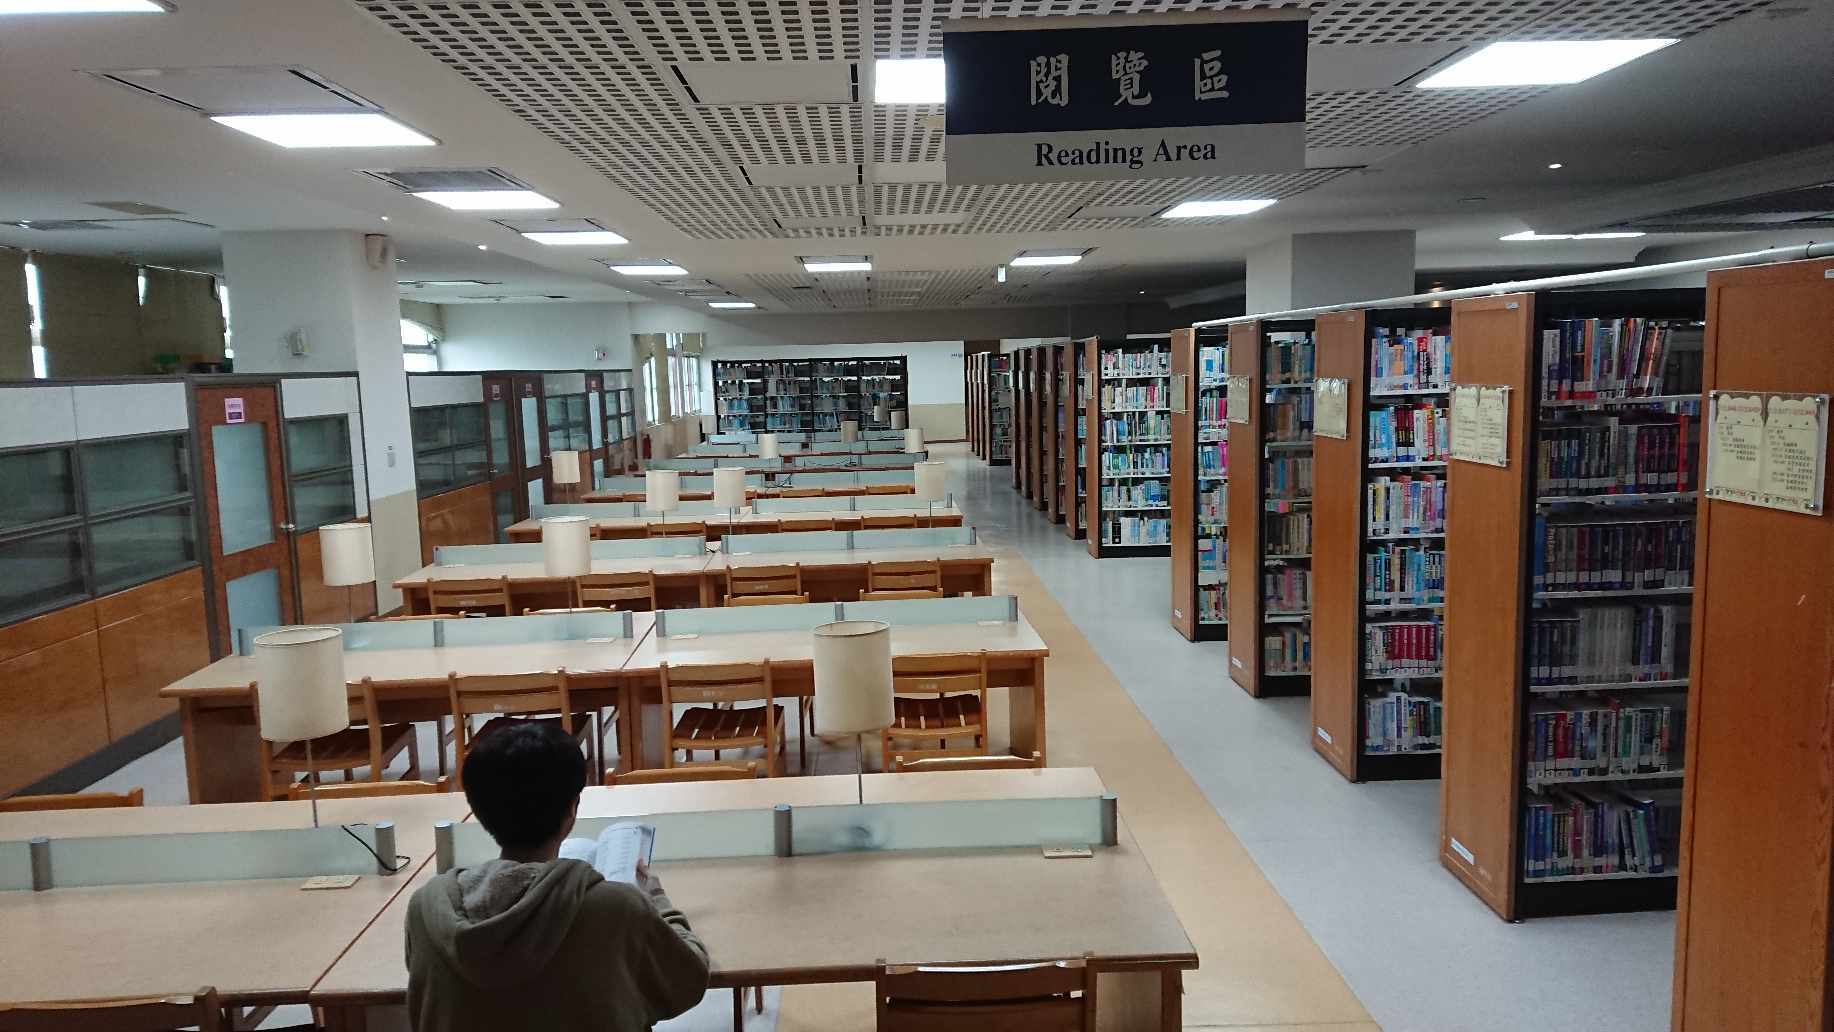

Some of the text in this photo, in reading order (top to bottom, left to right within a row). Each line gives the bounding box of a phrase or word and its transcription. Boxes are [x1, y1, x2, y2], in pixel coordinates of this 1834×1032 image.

[1029, 49, 1230, 106] 閱覽區
[1035, 138, 1216, 169] Reading Area
